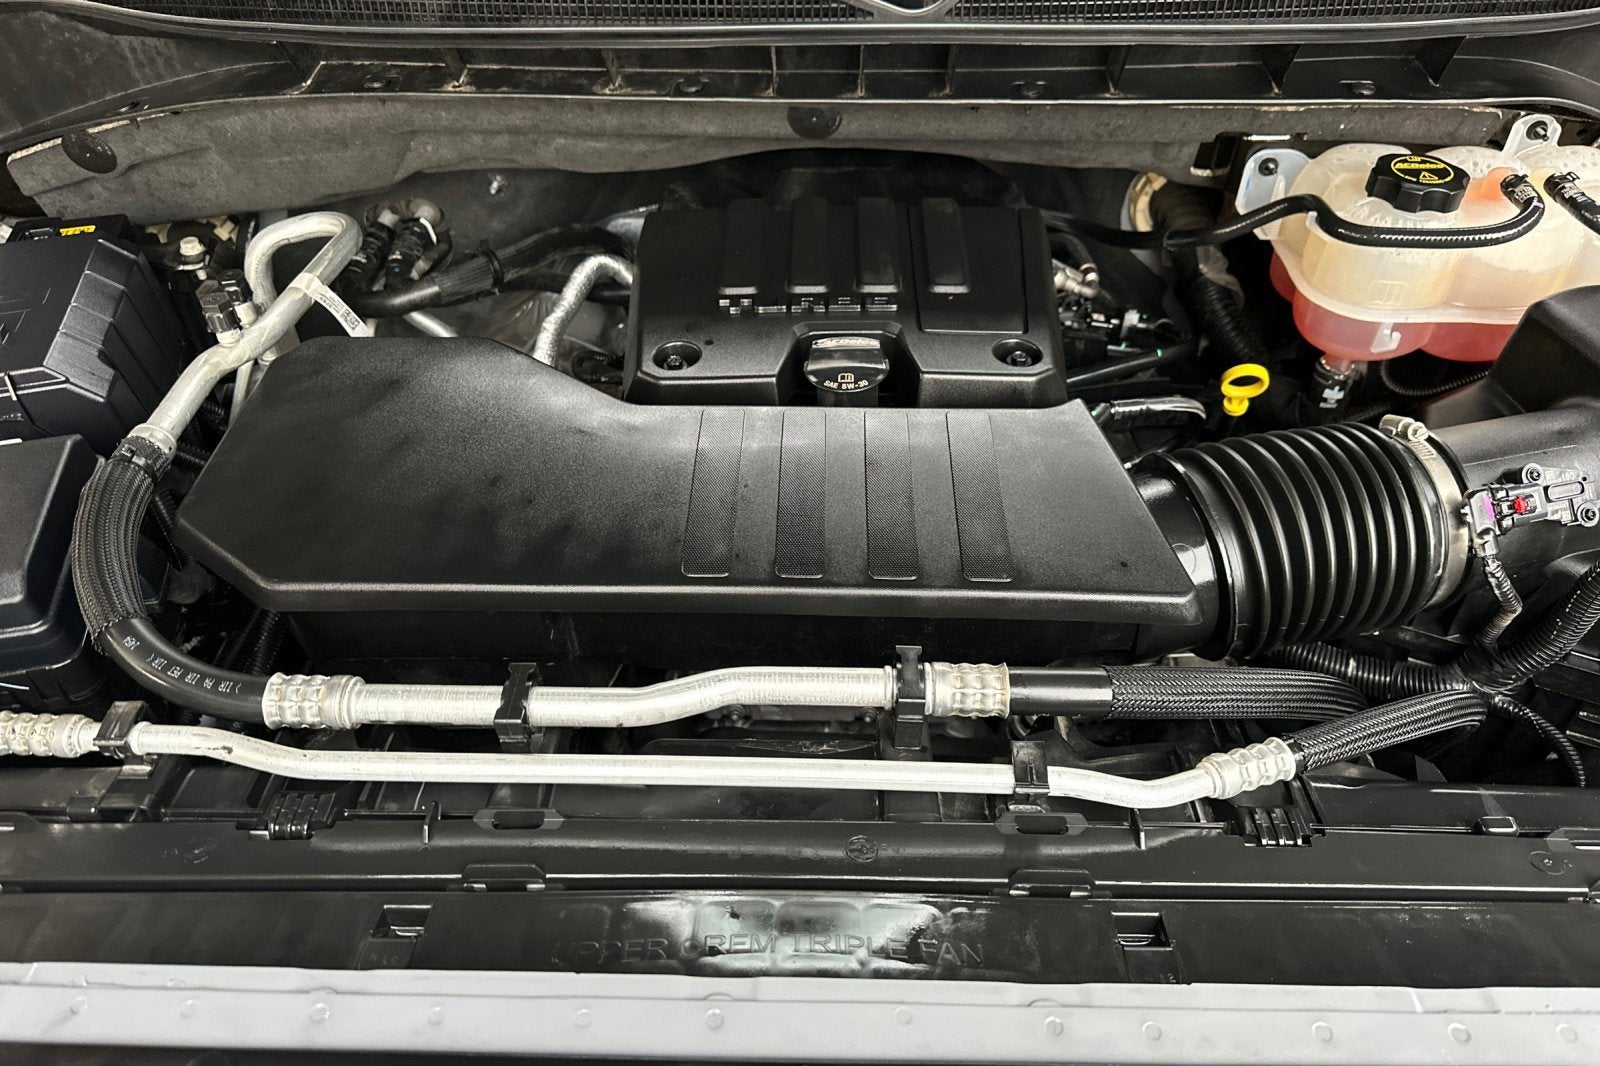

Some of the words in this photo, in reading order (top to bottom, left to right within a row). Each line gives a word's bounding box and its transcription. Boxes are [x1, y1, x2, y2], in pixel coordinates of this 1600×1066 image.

[823, 380, 839, 389] SAE
[841, 380, 869, 390] 5W-30
[787, 933, 908, 959] TRIPLE
[918, 938, 985, 967] FAN
